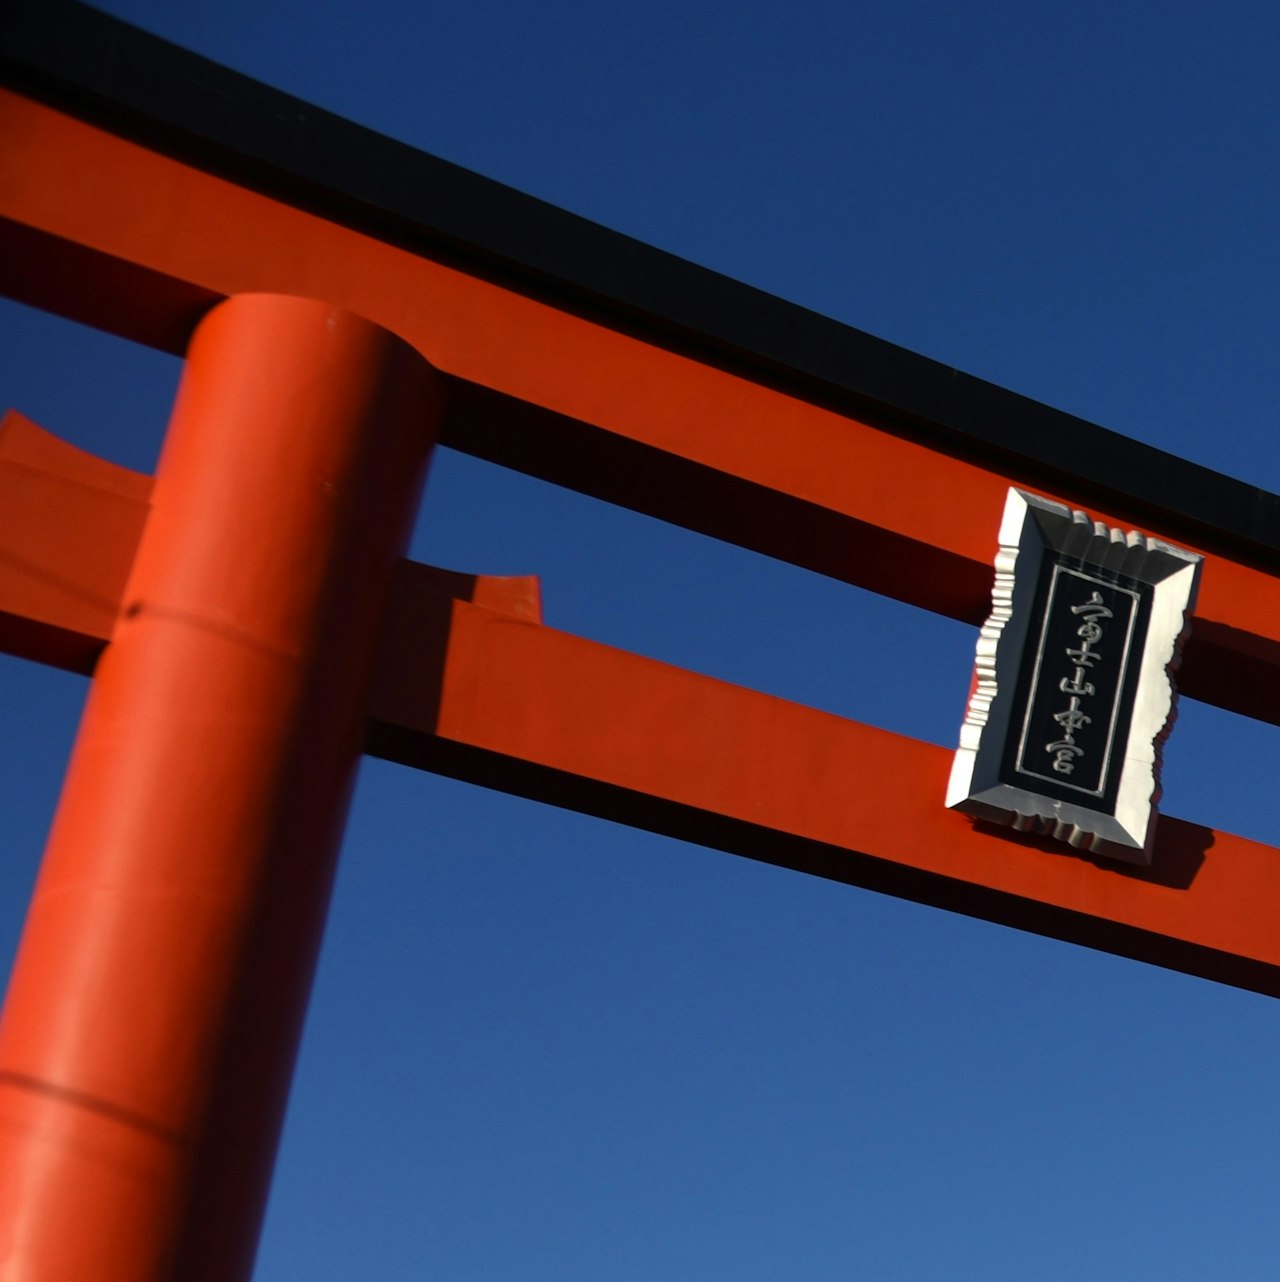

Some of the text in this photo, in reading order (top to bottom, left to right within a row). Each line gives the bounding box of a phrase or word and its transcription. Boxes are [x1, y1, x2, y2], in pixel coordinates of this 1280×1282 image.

[1045, 590, 1115, 775] 富士山本宮
